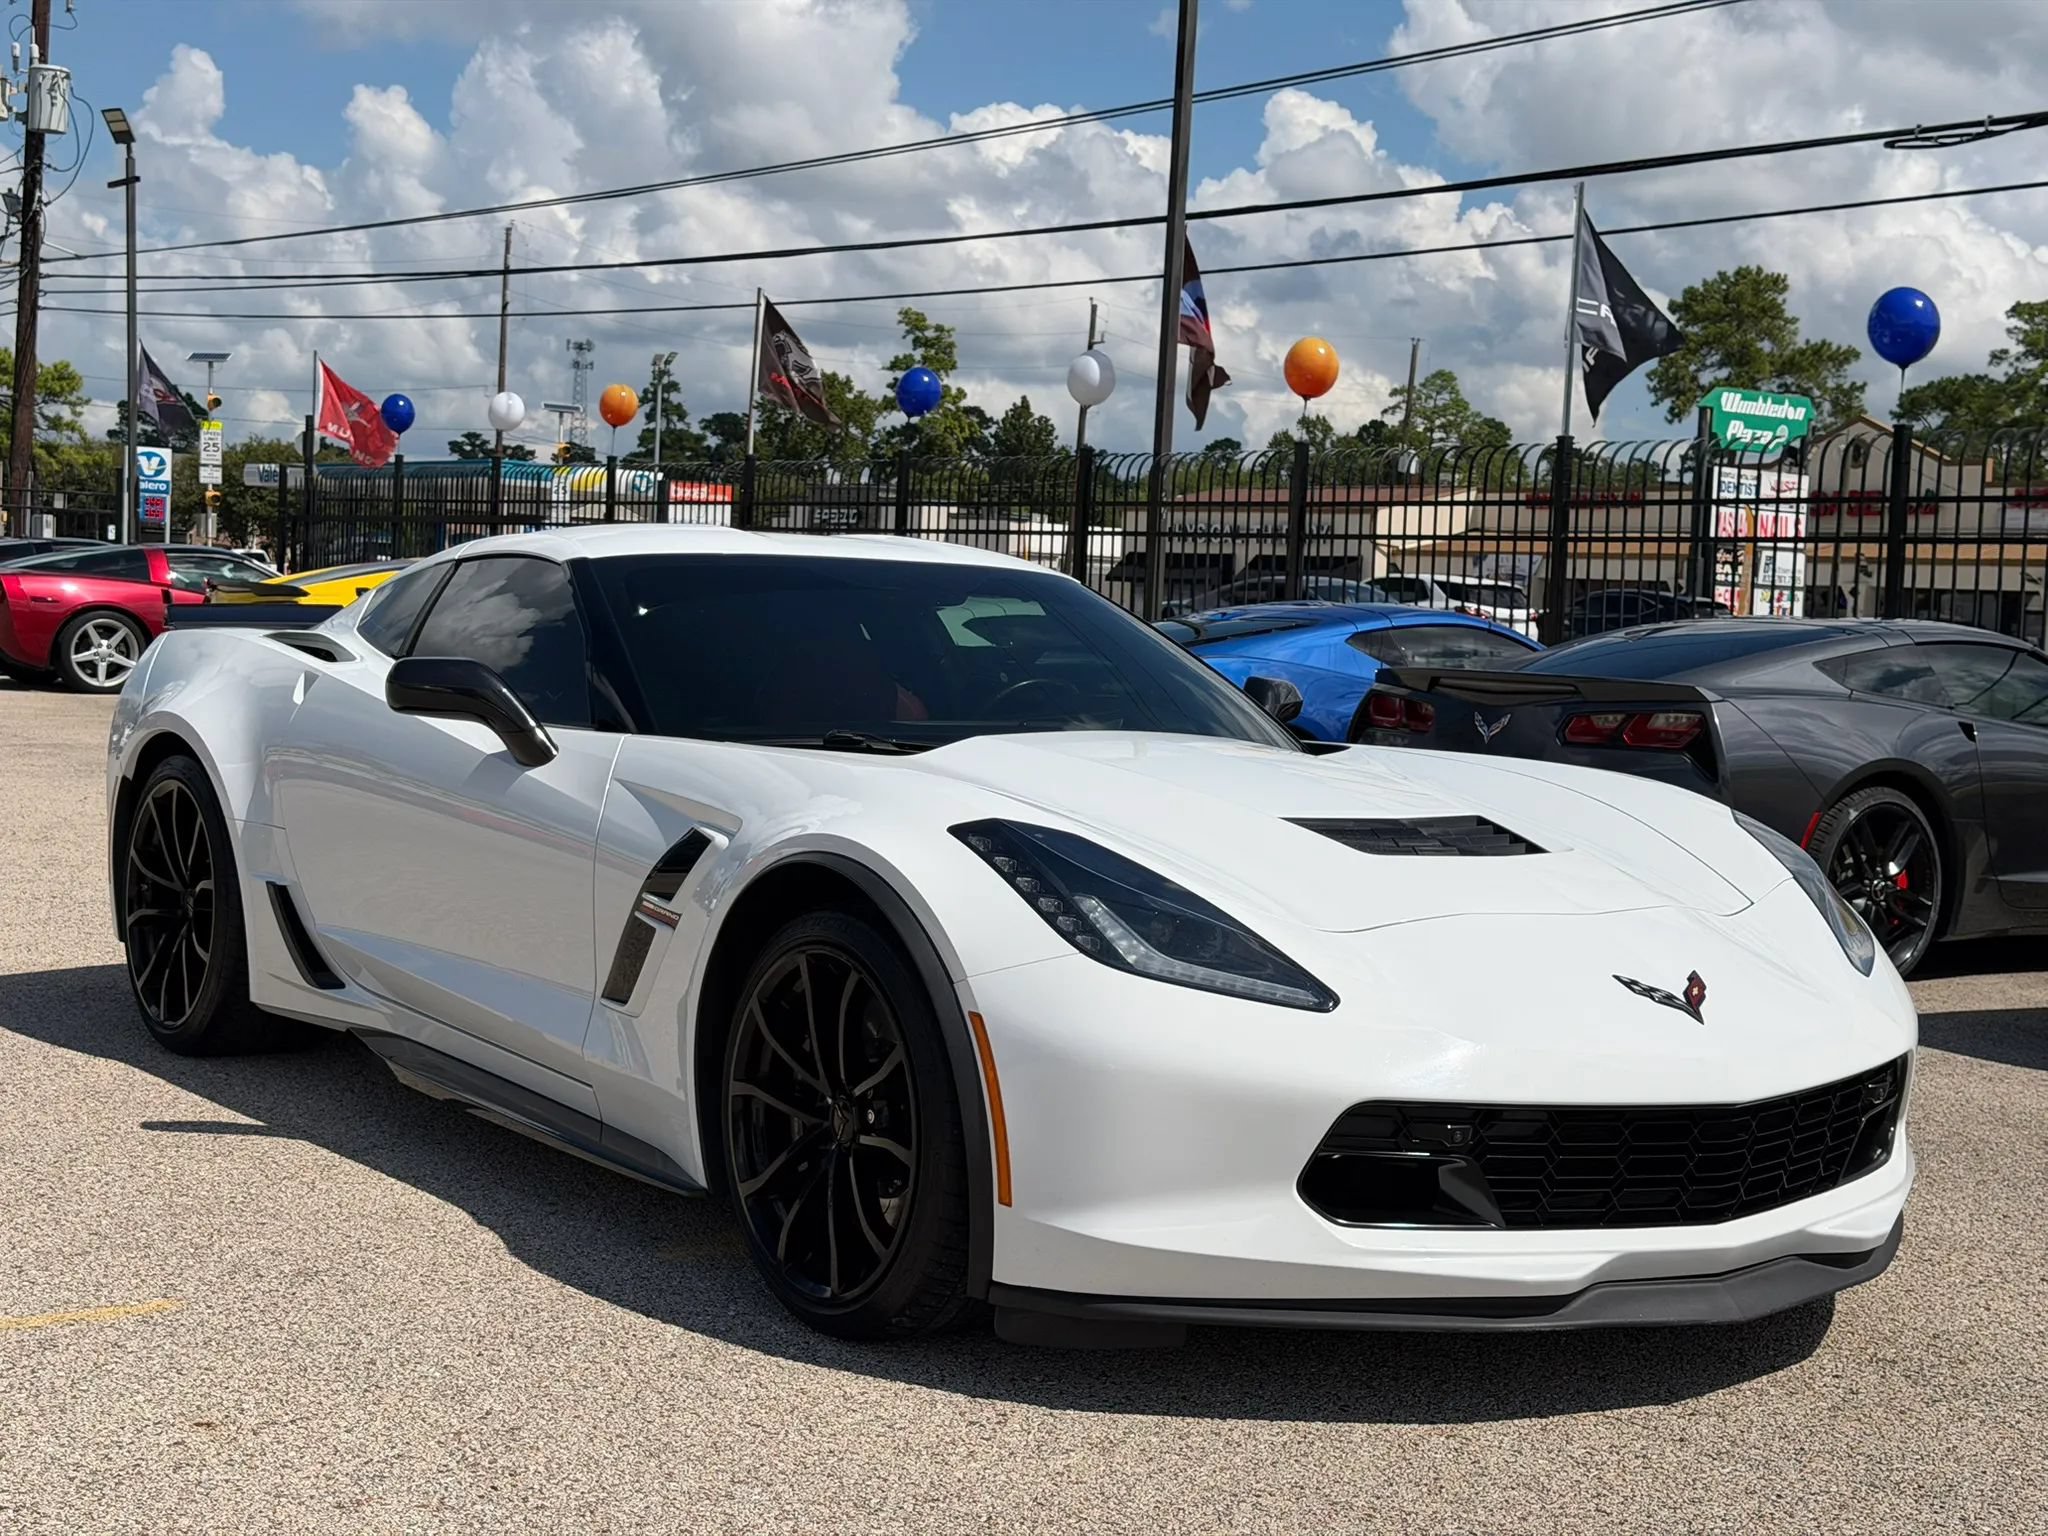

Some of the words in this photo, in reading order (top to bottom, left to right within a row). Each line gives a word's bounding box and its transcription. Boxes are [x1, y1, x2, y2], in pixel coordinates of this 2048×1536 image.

[1726, 419, 1774, 445] Plaza
[203, 442, 220, 453] 25
[139, 481, 167, 491] alero
[1719, 481, 1760, 495] DENTIS
